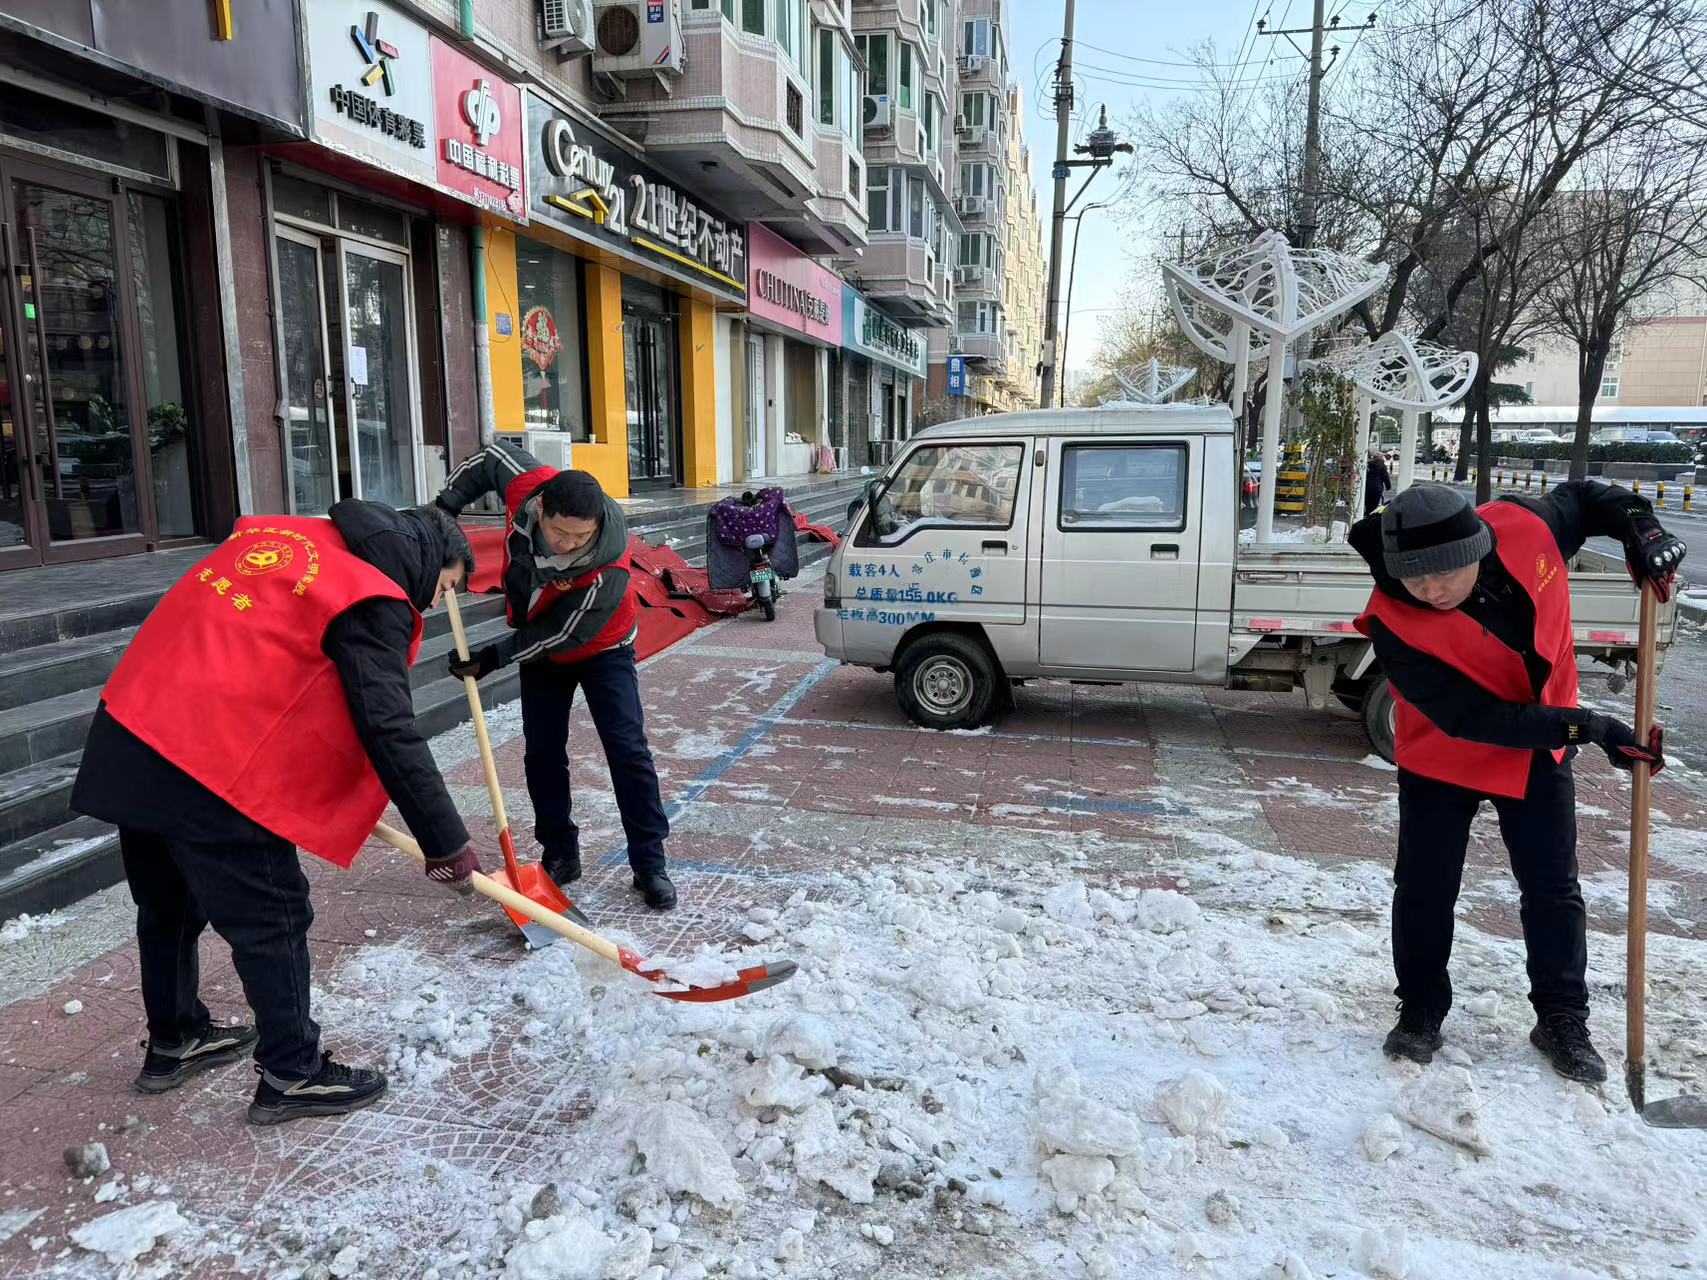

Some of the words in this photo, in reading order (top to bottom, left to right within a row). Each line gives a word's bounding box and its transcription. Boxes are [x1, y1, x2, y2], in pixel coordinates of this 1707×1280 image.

[330, 84, 425, 148] 中国体育彩票
[548, 119, 615, 197] Century
[629, 174, 743, 281] 21世纪不动产
[196, 567, 252, 611] 志愿者
[849, 563, 900, 578] 载客4人
